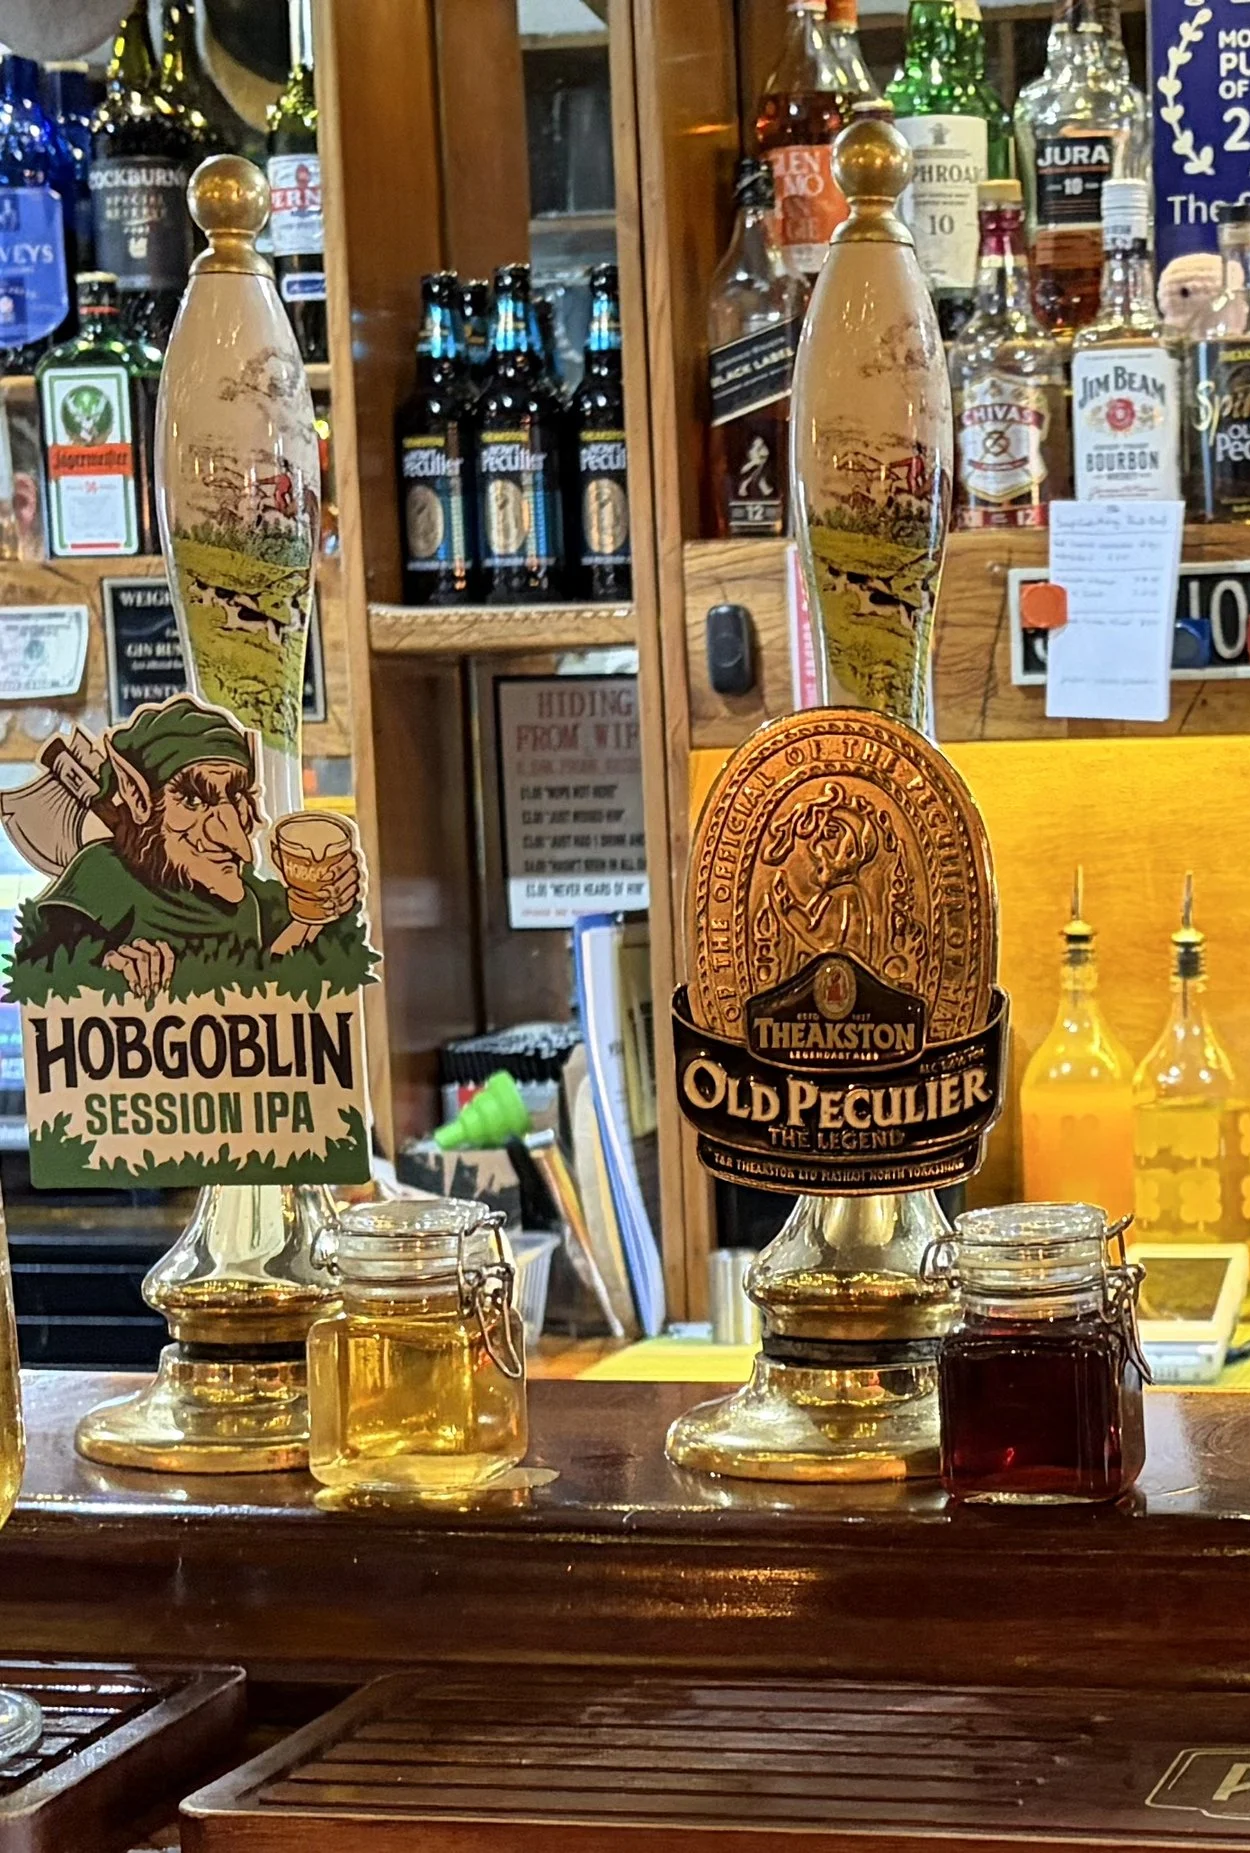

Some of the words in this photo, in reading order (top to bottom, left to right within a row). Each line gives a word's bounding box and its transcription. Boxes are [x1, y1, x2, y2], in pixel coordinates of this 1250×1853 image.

[1218, 80, 1250, 100] OF
[1037, 145, 1110, 167] JURA
[1064, 177, 1083, 195] 10
[1168, 194, 1220, 225] The
[928, 214, 955, 236] 10
[1078, 373, 1111, 408] JIM
[1112, 366, 1167, 404] BEAM
[961, 405, 1035, 427] CHIVAS
[1085, 450, 1161, 472] BOURBON
[1016, 509, 1036, 526] 12
[537, 688, 633, 720] HIDING
[516, 723, 580, 751] FROM
[594, 722, 640, 749] WIF
[753, 1018, 916, 1051] THEAKSTON
[28, 1011, 354, 1094] HOBGOBLIN
[683, 1058, 780, 1123] OLD
[786, 1066, 994, 1130] PECULIER
[84, 1091, 243, 1137] SESSION
[253, 1091, 316, 1135] IPA
[767, 1126, 811, 1149] THE
[816, 1127, 907, 1151] LEGEND
[736, 1159, 796, 1179] THEAKSTON
